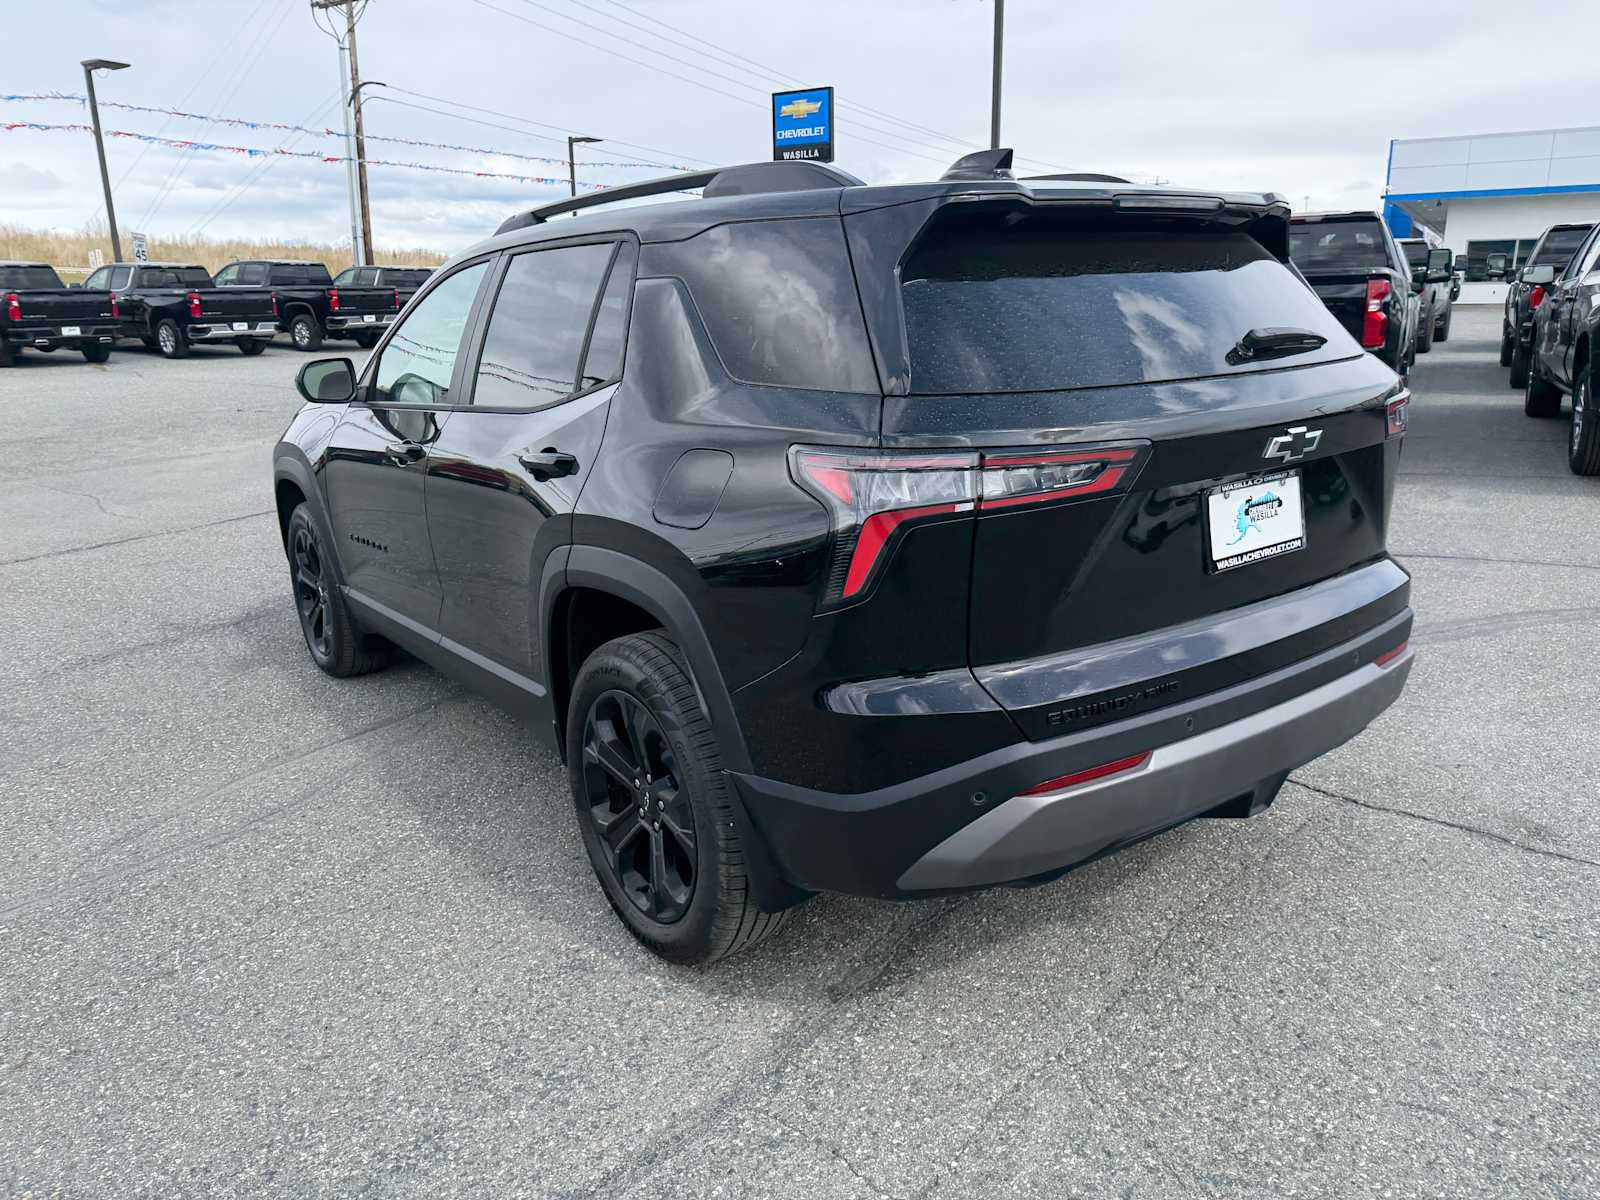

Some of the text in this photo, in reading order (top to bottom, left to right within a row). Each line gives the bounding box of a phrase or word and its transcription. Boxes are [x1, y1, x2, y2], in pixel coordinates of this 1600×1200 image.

[776, 126, 825, 139] CHEVROLET
[783, 149, 819, 160] WASILLA
[135, 249, 147, 261] 45
[1221, 479, 1253, 492] WASILLA
[1249, 509, 1279, 523] WASILLA
[1216, 539, 1302, 570] WASILLACHEVROLET.COM
